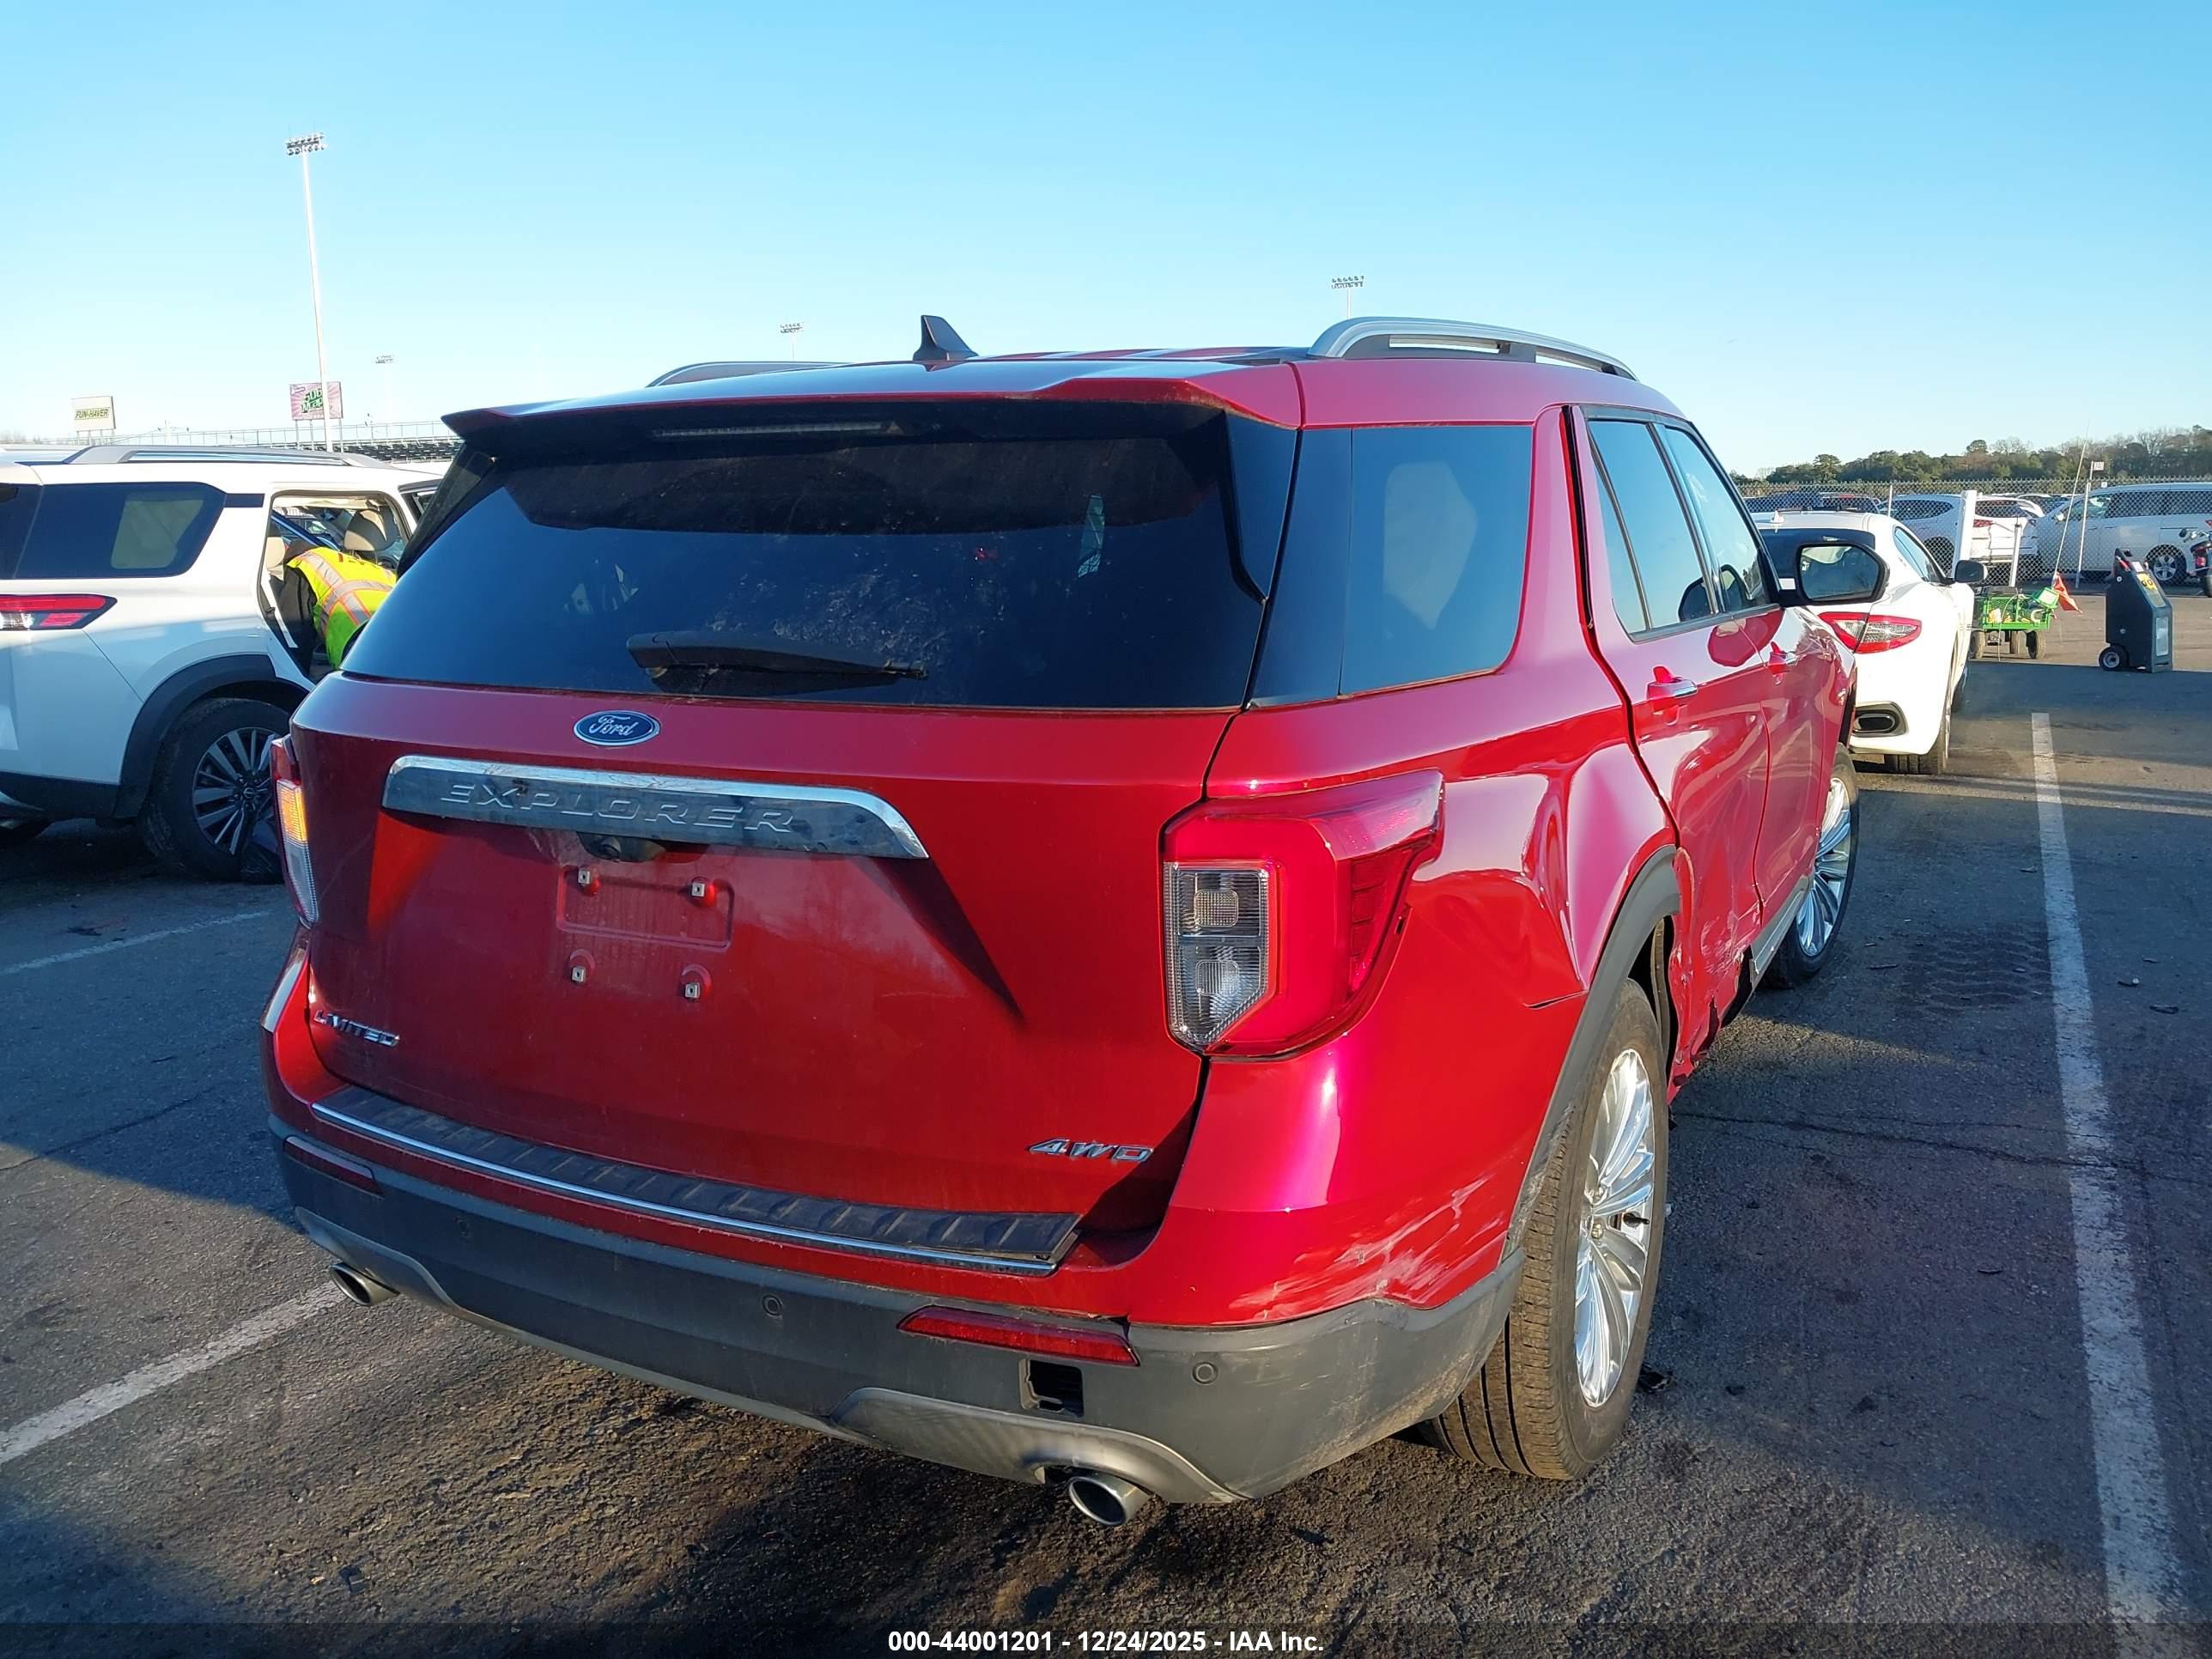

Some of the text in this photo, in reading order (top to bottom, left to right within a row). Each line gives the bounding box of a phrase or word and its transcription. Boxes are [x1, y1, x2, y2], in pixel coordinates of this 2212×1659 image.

[588, 714, 639, 736] Ford
[441, 783, 795, 833] EXPLORER
[313, 1009, 400, 1047] LIMITED
[1030, 1139, 1155, 1162] 4WD
